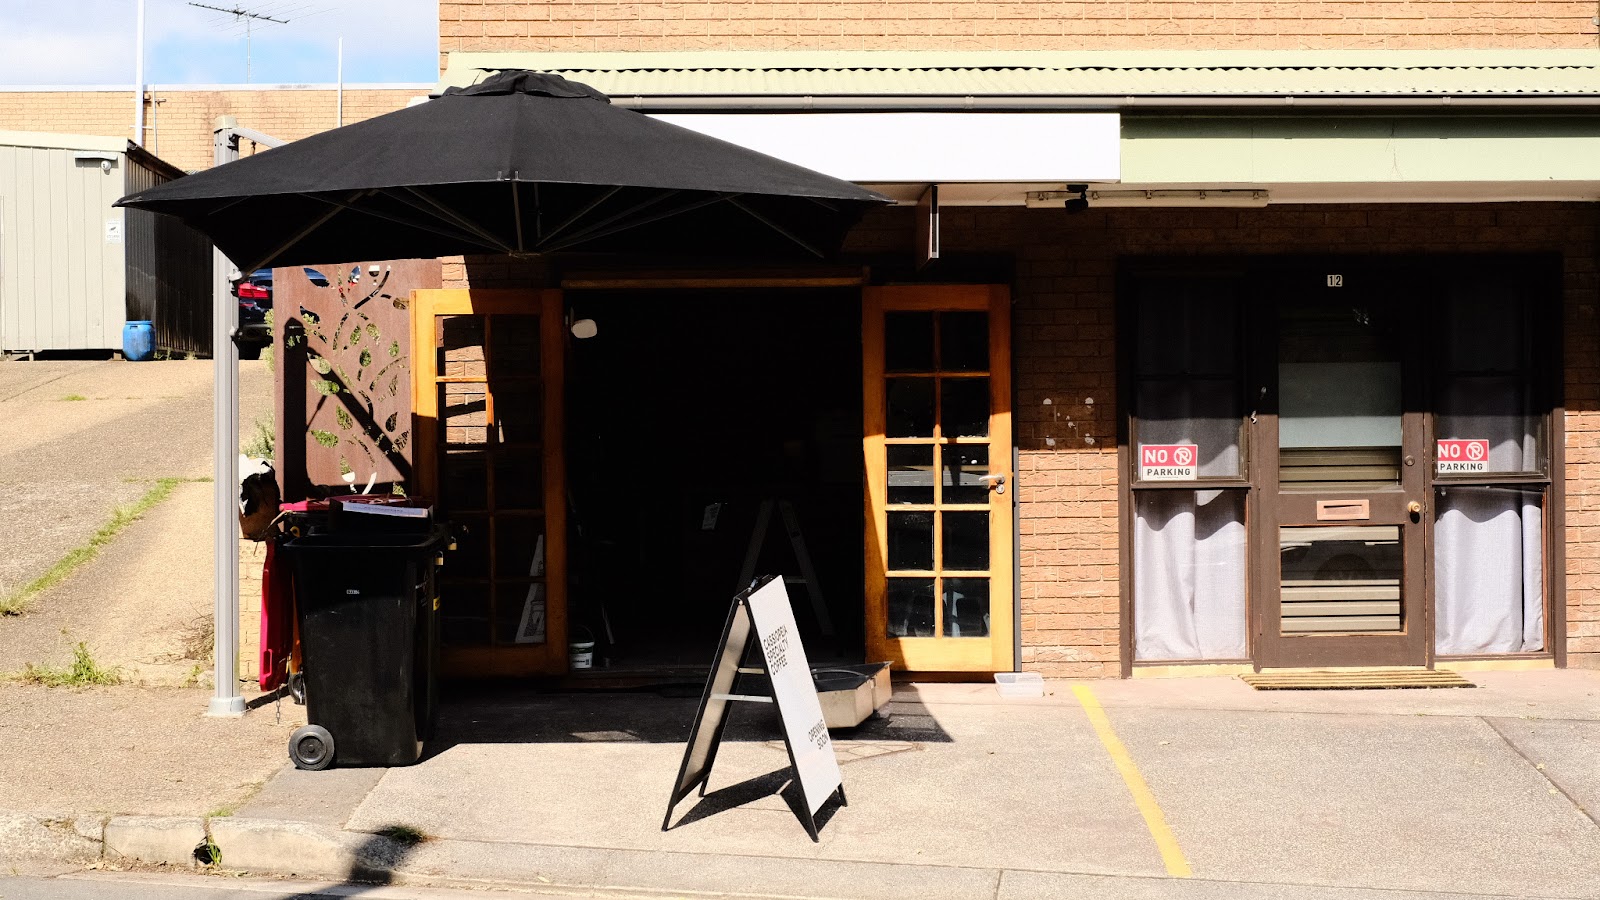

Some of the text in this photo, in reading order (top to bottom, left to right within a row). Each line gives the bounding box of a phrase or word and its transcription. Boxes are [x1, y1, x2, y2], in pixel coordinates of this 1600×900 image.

[1328, 275, 1342, 286] 12
[1145, 449, 1168, 463] NO
[1438, 444, 1460, 458] NO
[1147, 468, 1191, 476] PARKING
[766, 637, 789, 662] SPECIALTY
[770, 654, 788, 675] COFFEE
[808, 719, 825, 742] OPENING
[816, 731, 829, 750] SOON
